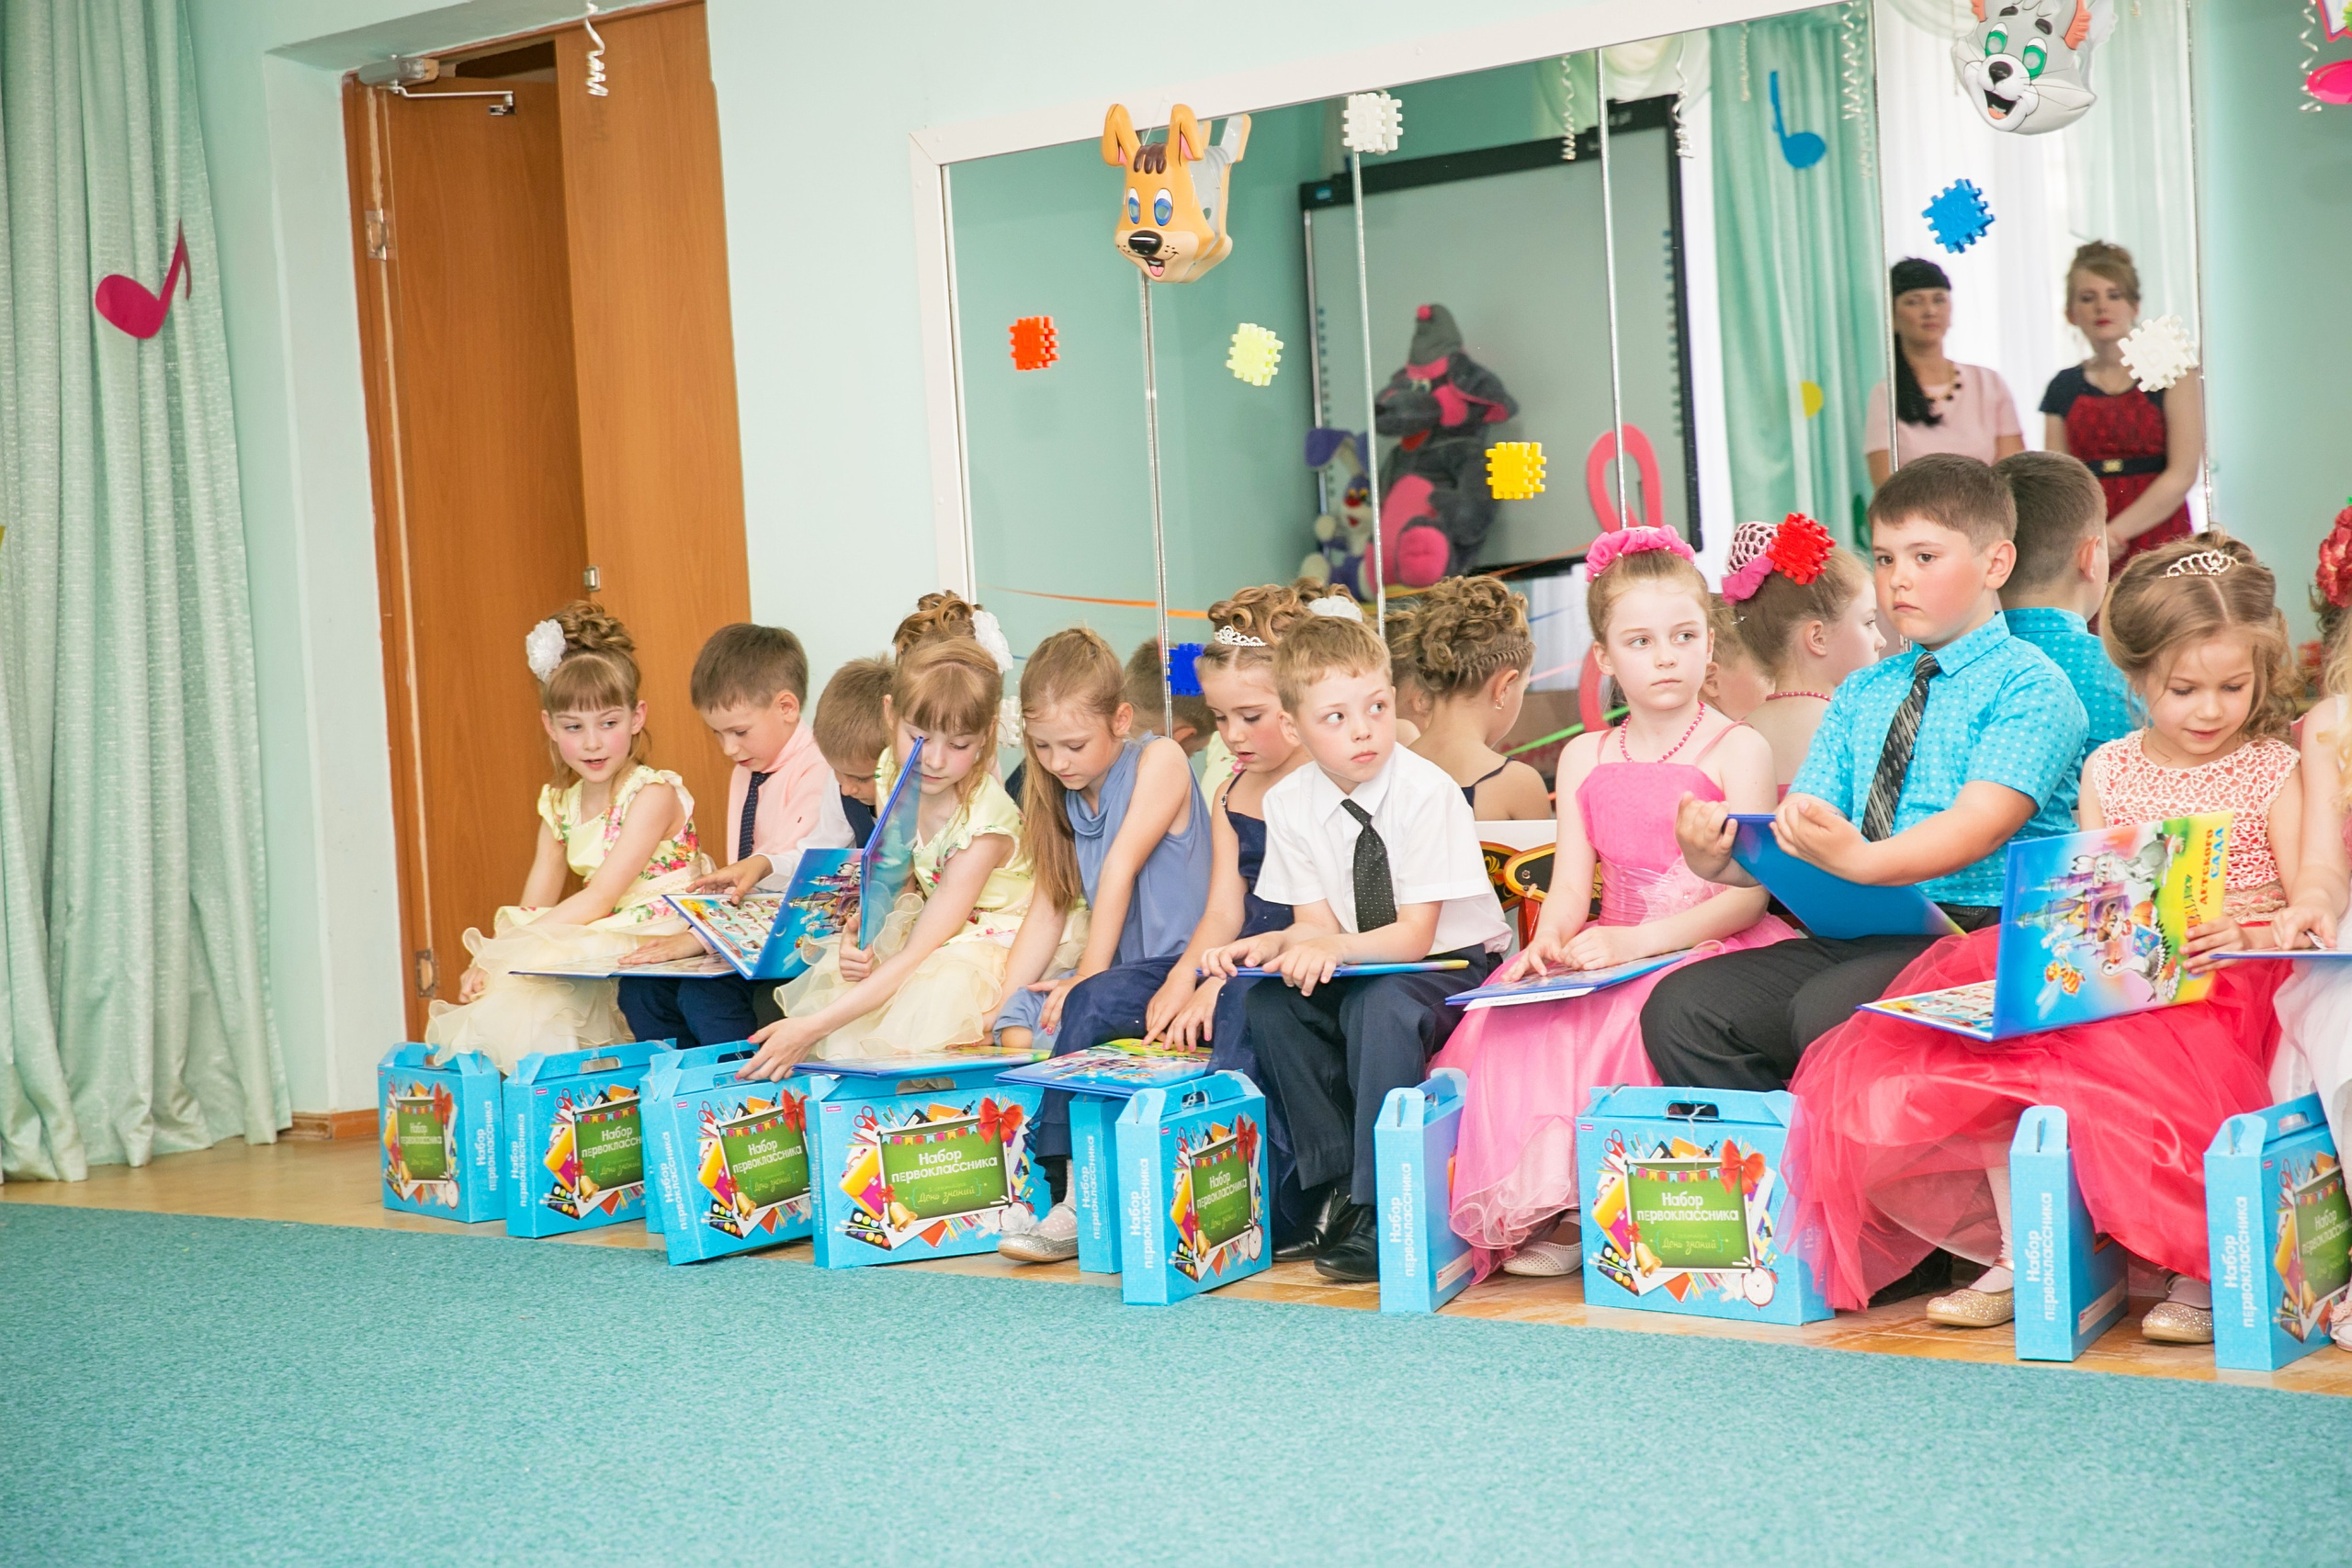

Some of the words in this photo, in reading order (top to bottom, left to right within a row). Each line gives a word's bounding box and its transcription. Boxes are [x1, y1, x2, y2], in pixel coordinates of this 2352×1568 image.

[474, 1129, 487, 1166] Набор
[484, 1100, 499, 1191] первоклассника
[582, 1135, 642, 1158] первоклассн
[601, 1125, 633, 1142] Набор
[748, 1139, 778, 1156] Набор
[510, 1141, 520, 1179] Набор
[732, 1145, 803, 1174] первоклассника
[891, 1156, 998, 1183] первоклассника
[919, 1148, 962, 1166] Набор
[660, 1163, 674, 1203] Набор
[662, 1132, 687, 1230] первоклассника
[1080, 1166, 1091, 1208] Набор
[1087, 1135, 1102, 1239] первоклассника
[1196, 1178, 1248, 1210] первоклассника
[1209, 1170, 1231, 1190] Набор
[1127, 1190, 1142, 1236] Набор
[1139, 1157, 1156, 1269] первоклассника
[1387, 1196, 1403, 1243] Набор
[1636, 1210, 1739, 1224] первоклассника
[1661, 1190, 1703, 1210] Набор
[1401, 1163, 1418, 1277] первоклассника
[2314, 1209, 2337, 1231] Набор
[2024, 1230, 2042, 1282] Набор
[2041, 1192, 2058, 1321] первоклассника
[2222, 1235, 2239, 1289] Набор
[2235, 1196, 2257, 1328] первоклассника
